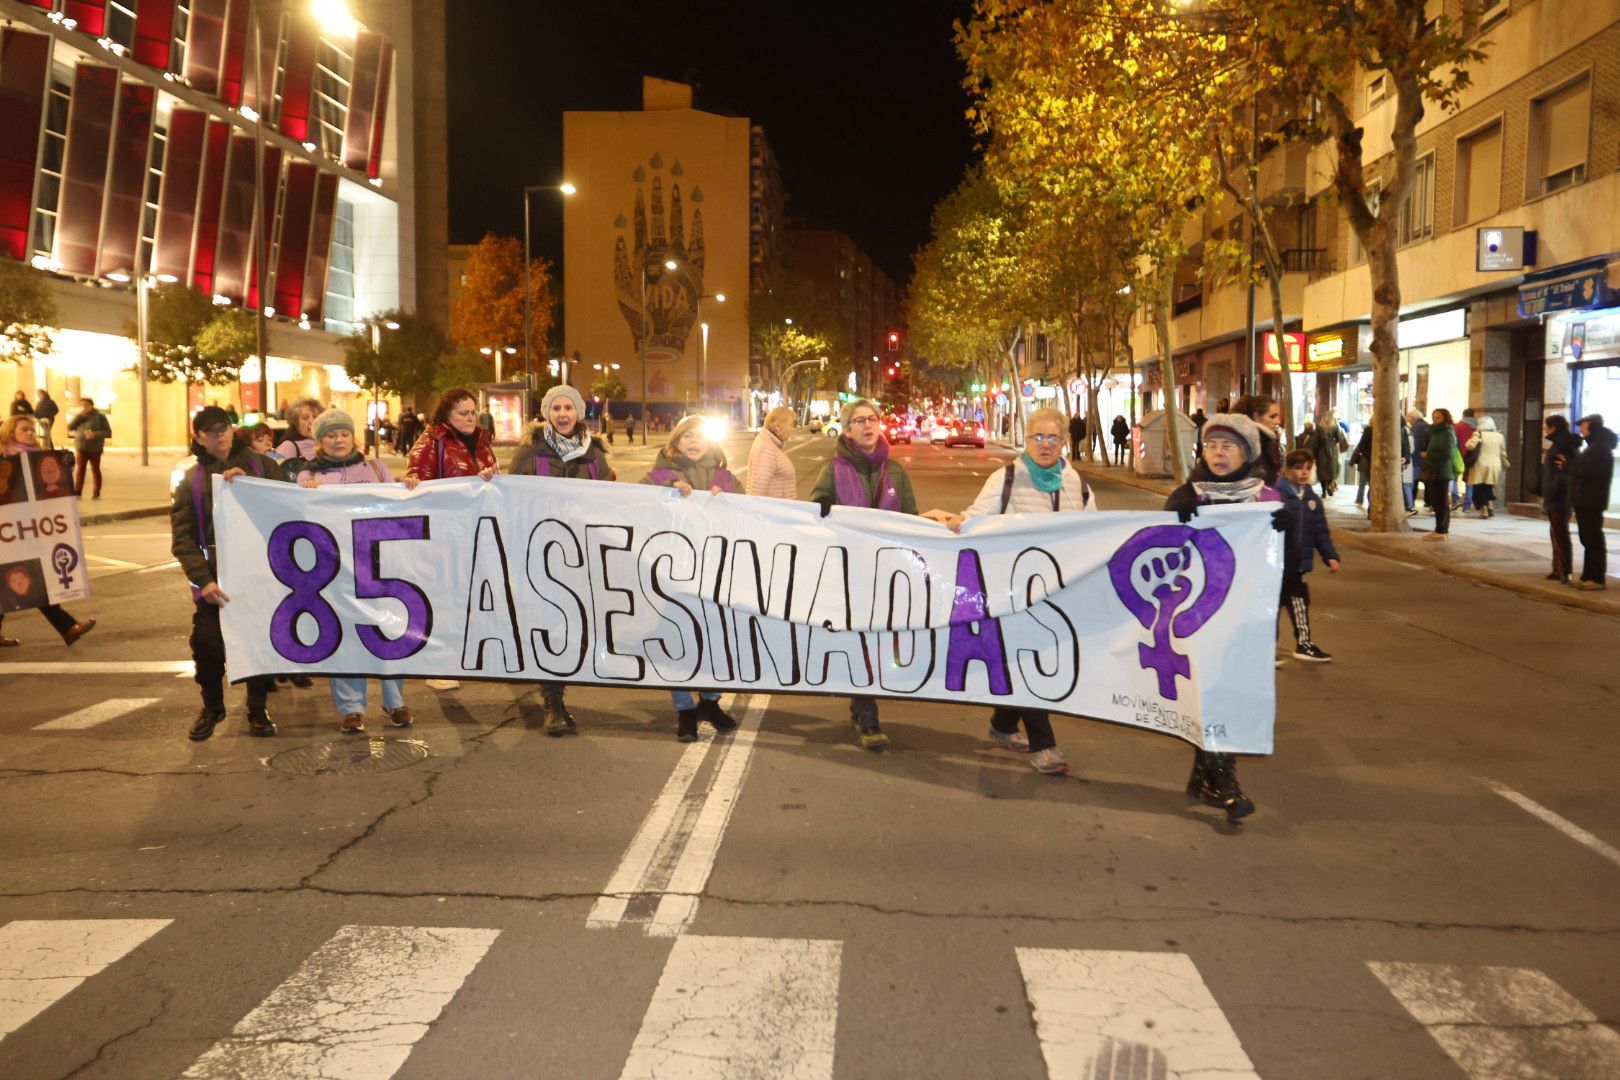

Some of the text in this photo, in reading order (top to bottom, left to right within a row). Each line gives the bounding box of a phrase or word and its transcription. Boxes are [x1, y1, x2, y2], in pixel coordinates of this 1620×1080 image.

[0, 514, 68, 542] CHOS
[267, 514, 1080, 702] 85 ASESINADAS
[1111, 693, 1179, 721] MOVIMIENTO
[1135, 712, 1151, 724] DE
